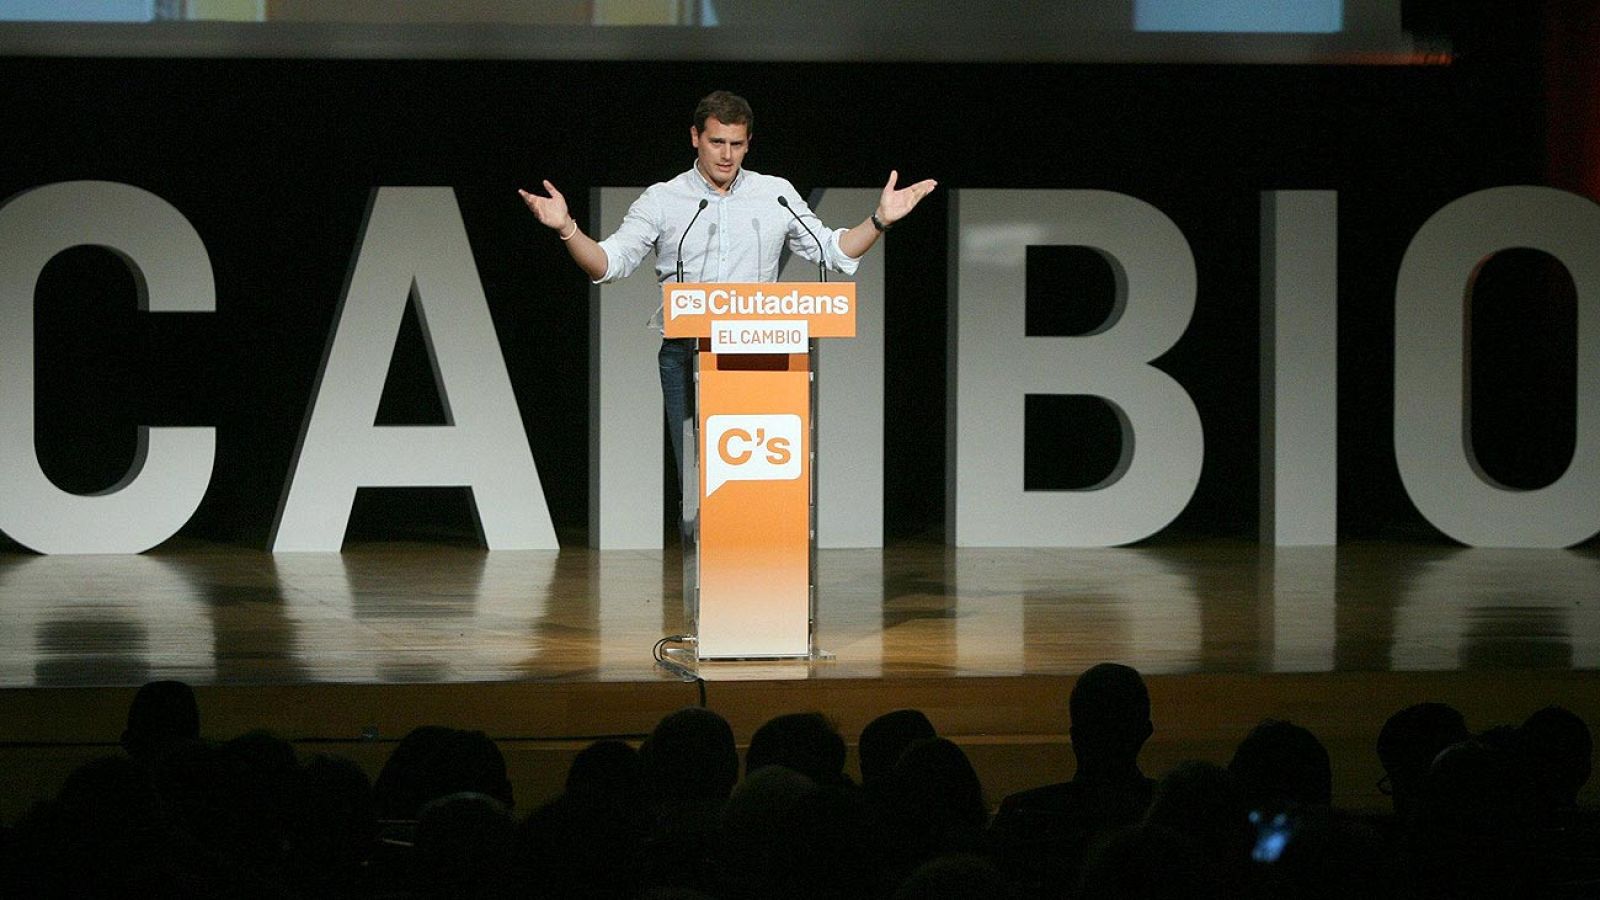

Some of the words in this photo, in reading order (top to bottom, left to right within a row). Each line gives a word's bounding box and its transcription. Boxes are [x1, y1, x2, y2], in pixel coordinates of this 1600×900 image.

[674, 294, 702, 309] C's
[708, 290, 849, 315] Ciutadans
[718, 330, 737, 344] EL
[740, 330, 802, 344] CAMBIO
[717, 428, 791, 466] C's
